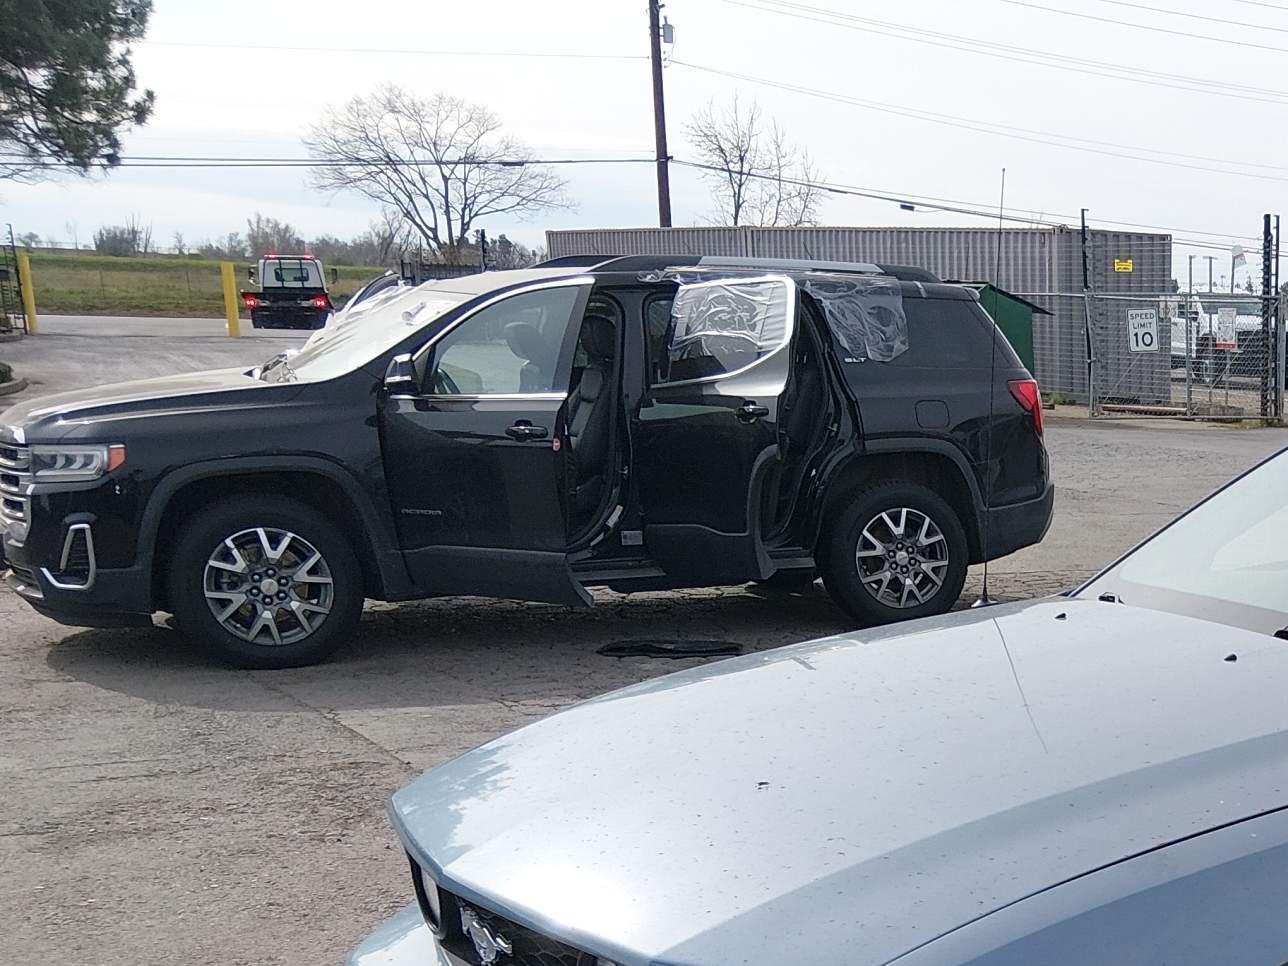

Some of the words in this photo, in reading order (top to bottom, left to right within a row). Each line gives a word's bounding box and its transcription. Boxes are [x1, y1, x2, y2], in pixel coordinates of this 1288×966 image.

[1129, 312, 1155, 321] SPEED
[1132, 322, 1153, 330] LIMIT
[1133, 331, 1154, 348] 10
